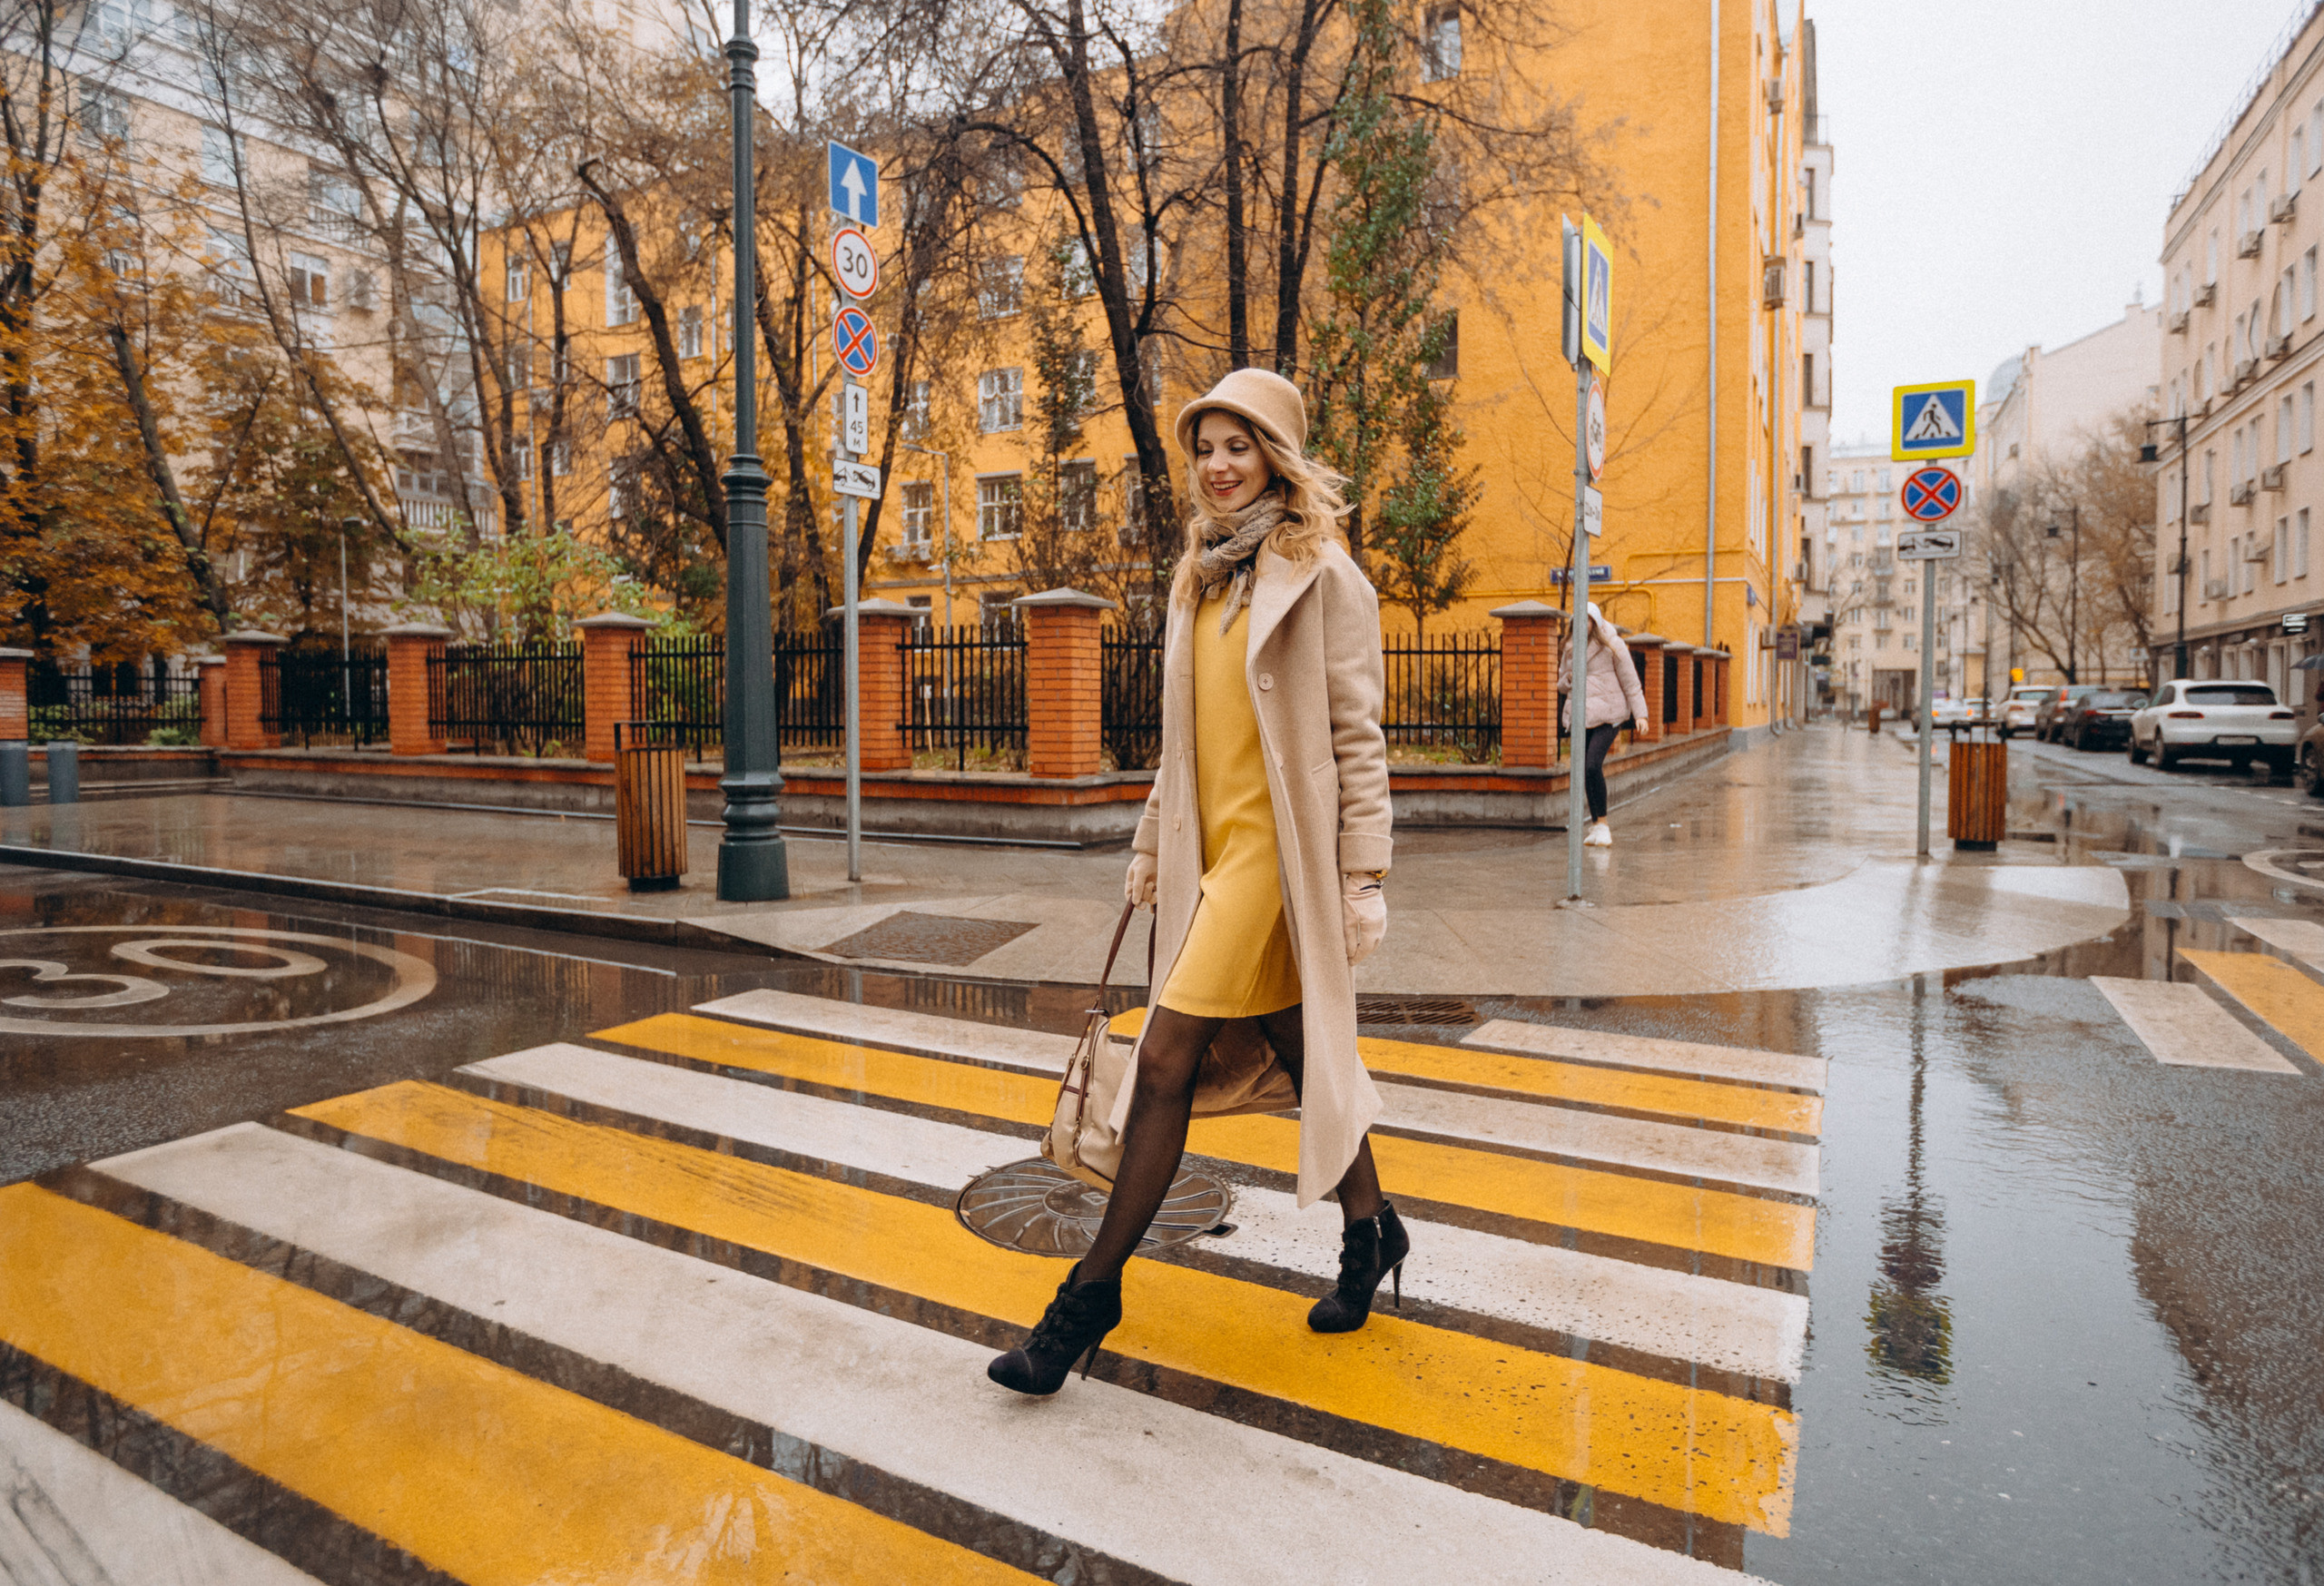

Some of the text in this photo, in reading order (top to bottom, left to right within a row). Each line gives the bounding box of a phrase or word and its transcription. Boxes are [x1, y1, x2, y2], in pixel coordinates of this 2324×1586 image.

[842, 246, 868, 279] 30
[851, 420, 863, 434] 45
[0, 939, 329, 1009] 30
